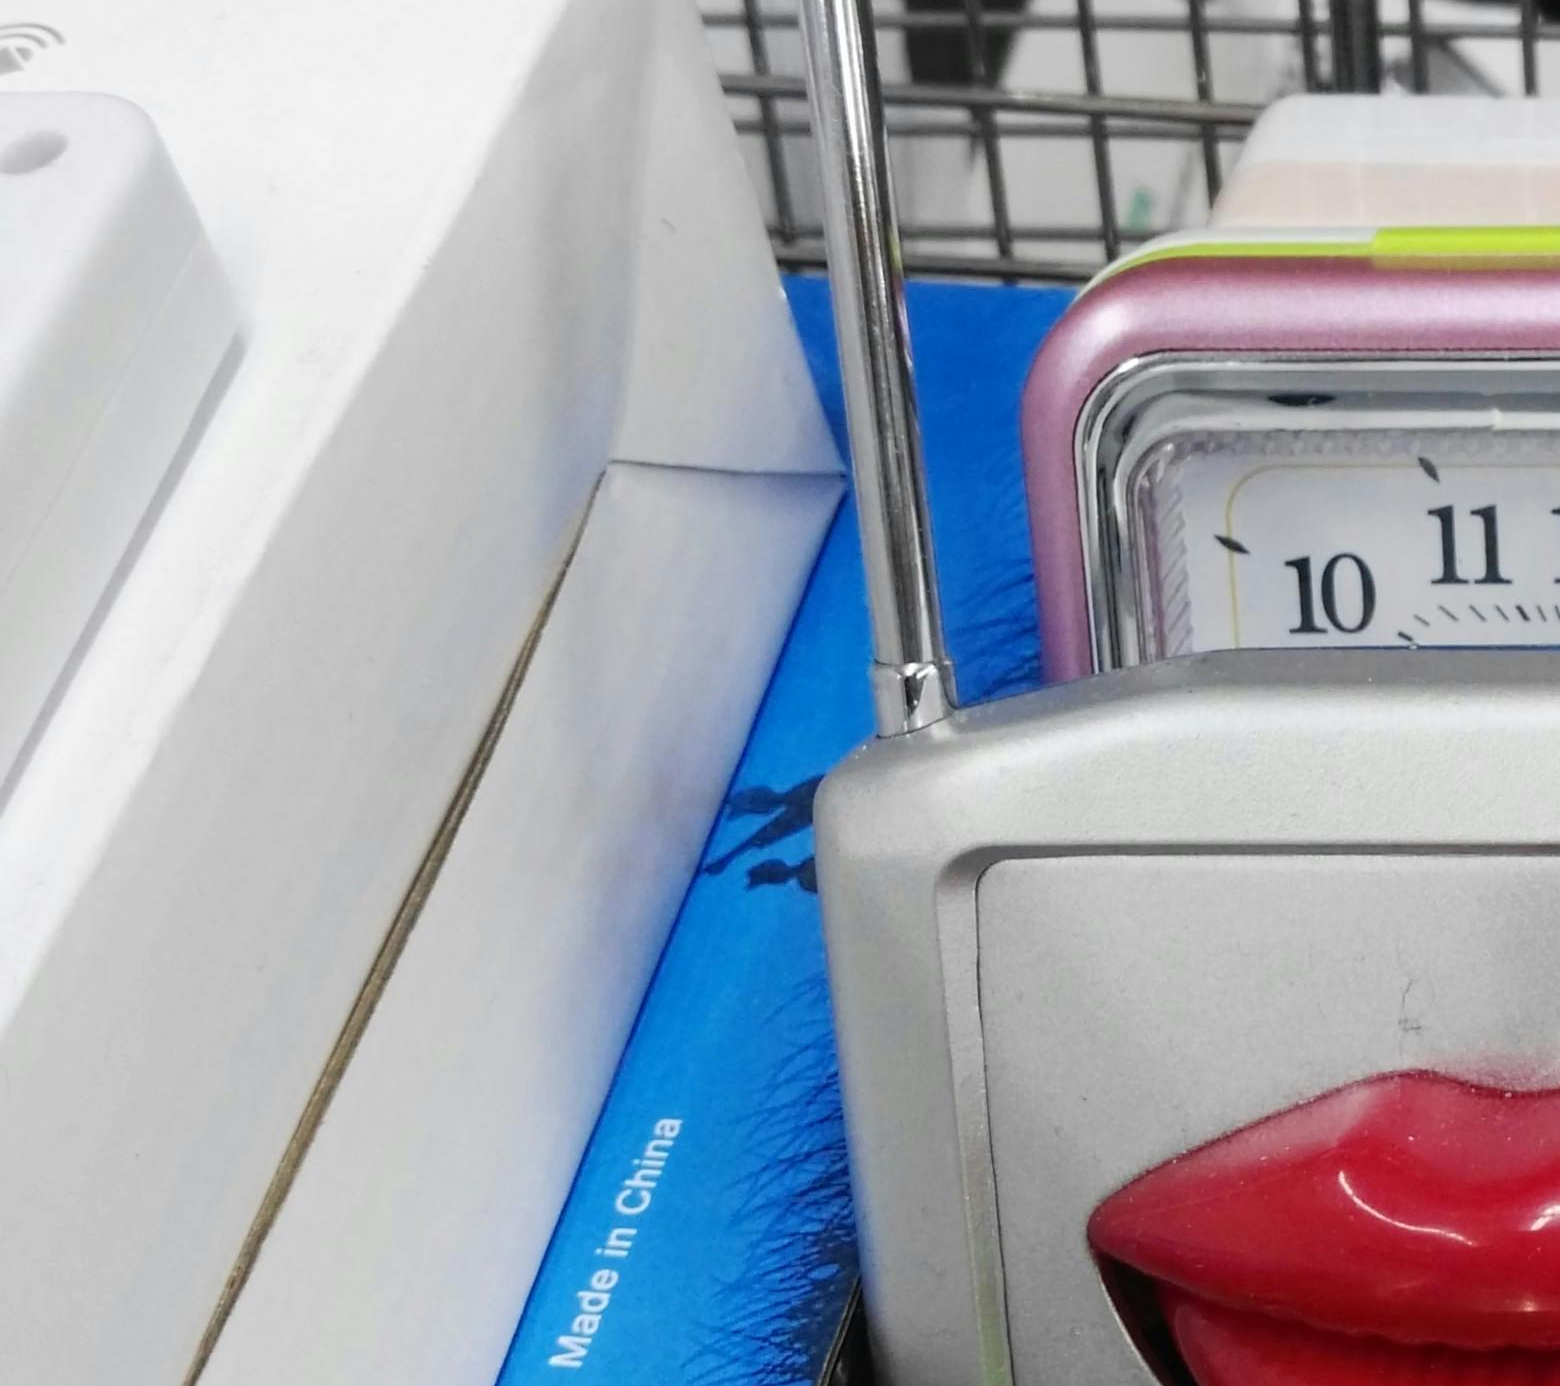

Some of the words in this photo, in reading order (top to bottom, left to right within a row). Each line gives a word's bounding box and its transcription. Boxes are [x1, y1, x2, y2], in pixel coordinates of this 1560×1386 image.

[1427, 503, 1513, 585] 11
[1285, 553, 1377, 635] 10
[615, 1117, 684, 1215] China
[594, 1226, 638, 1258] in
[548, 1268, 619, 1368] Made
